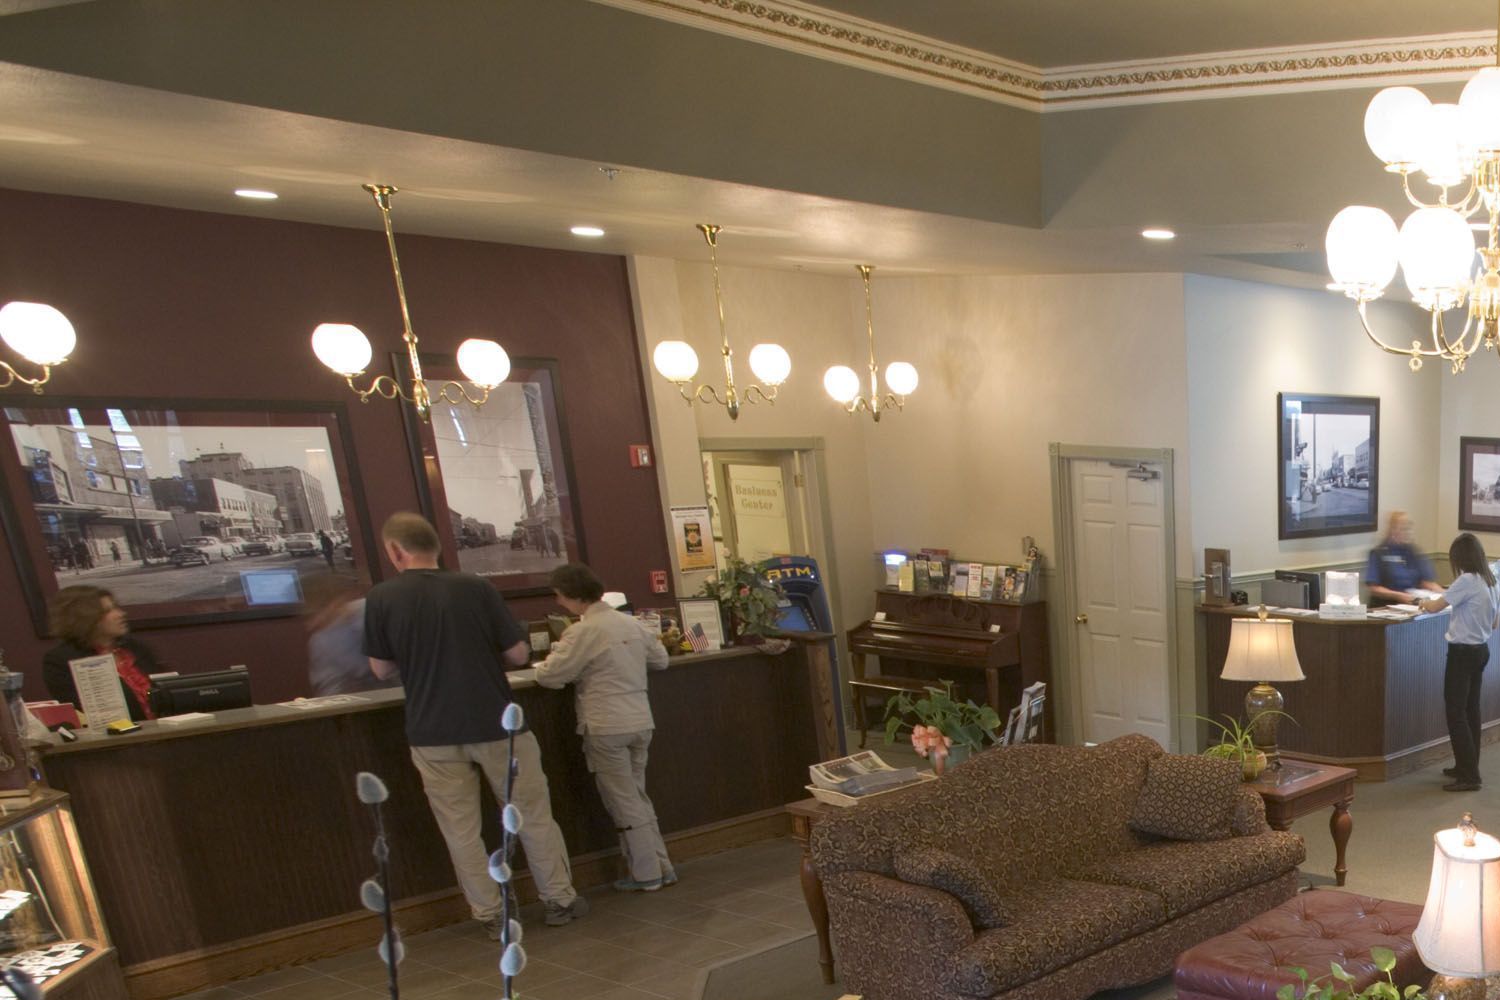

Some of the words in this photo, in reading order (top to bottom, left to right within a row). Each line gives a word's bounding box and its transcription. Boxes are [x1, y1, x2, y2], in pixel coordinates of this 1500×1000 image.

[735, 485, 778, 497] Business
[741, 498, 773, 511] Center
[767, 566, 811, 580] ATM
